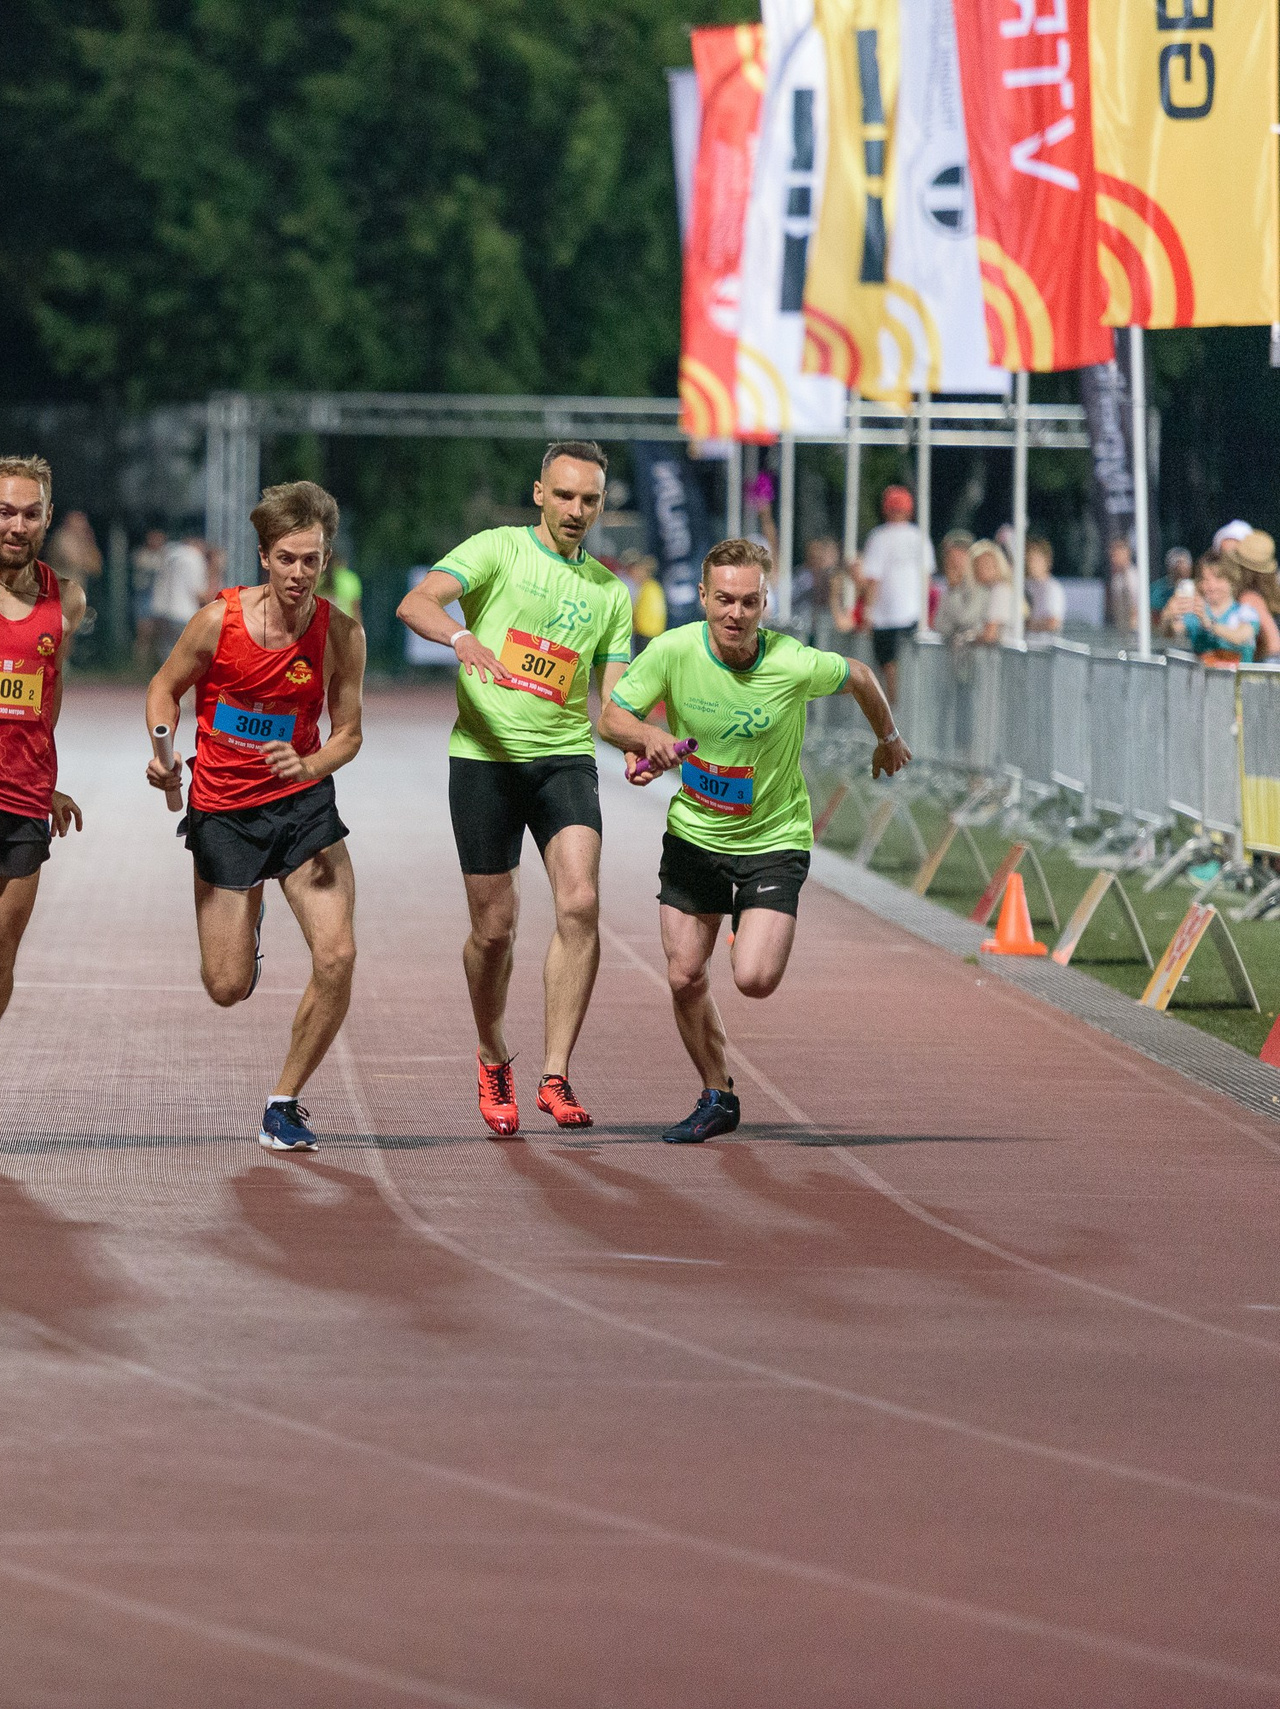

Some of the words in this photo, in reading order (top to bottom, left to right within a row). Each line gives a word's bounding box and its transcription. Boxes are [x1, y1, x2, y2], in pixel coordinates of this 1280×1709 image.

[521, 653, 557, 679] 307
[558, 675, 566, 685] 2
[29, 689, 34, 700] 2
[684, 702, 715, 713] марафон
[236, 715, 273, 737] 308
[278, 728, 285, 737] 3
[699, 775, 729, 797] 307
[738, 790, 744, 800] 3
